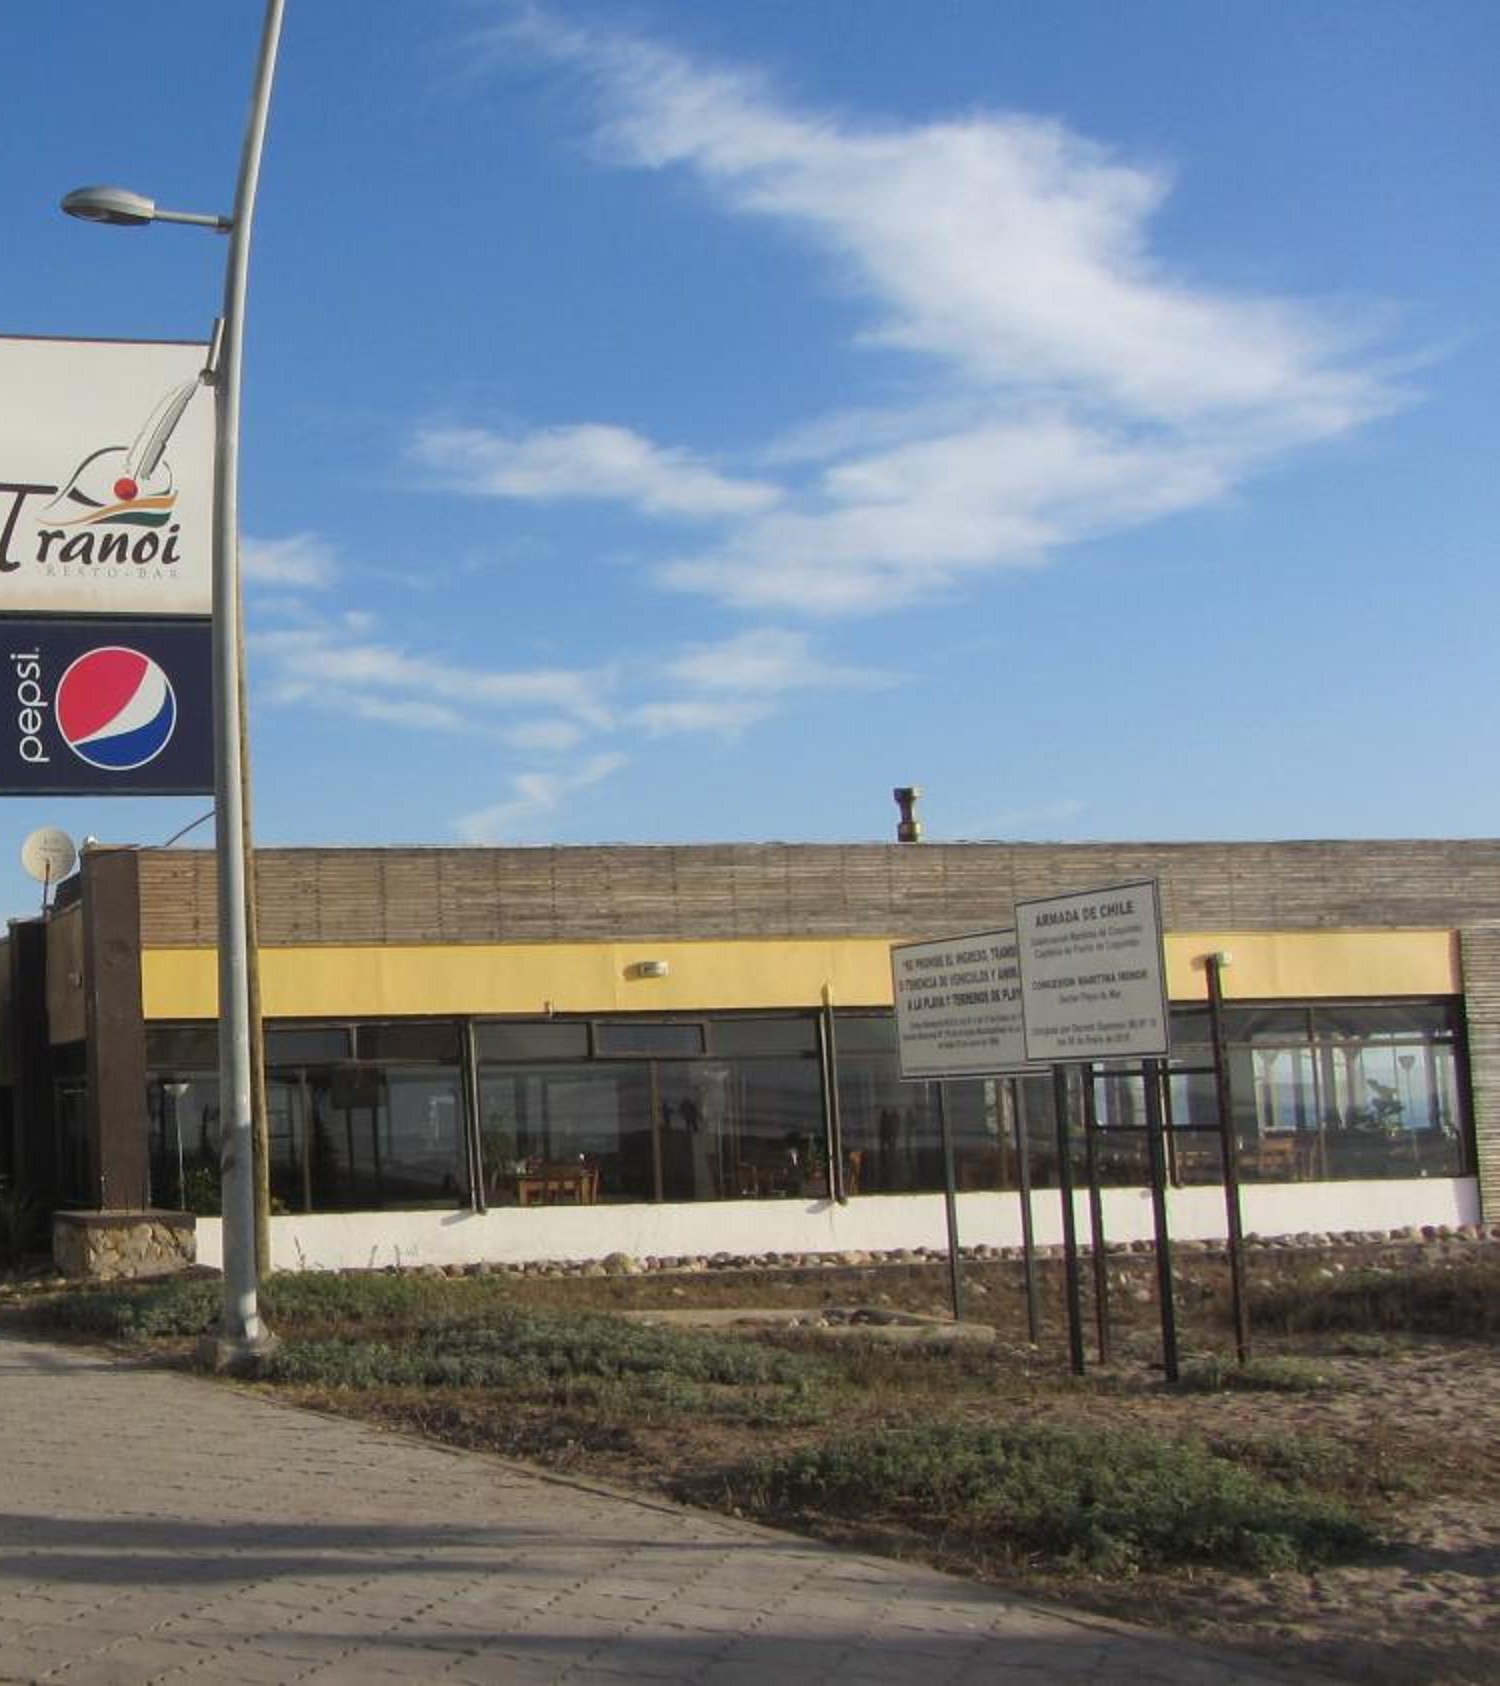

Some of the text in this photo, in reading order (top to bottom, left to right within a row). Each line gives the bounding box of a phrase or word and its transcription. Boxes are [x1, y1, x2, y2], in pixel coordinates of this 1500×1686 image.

[10, 653, 50, 763] pepsi
[1035, 900, 1135, 927] ARMADA DE CHILE
